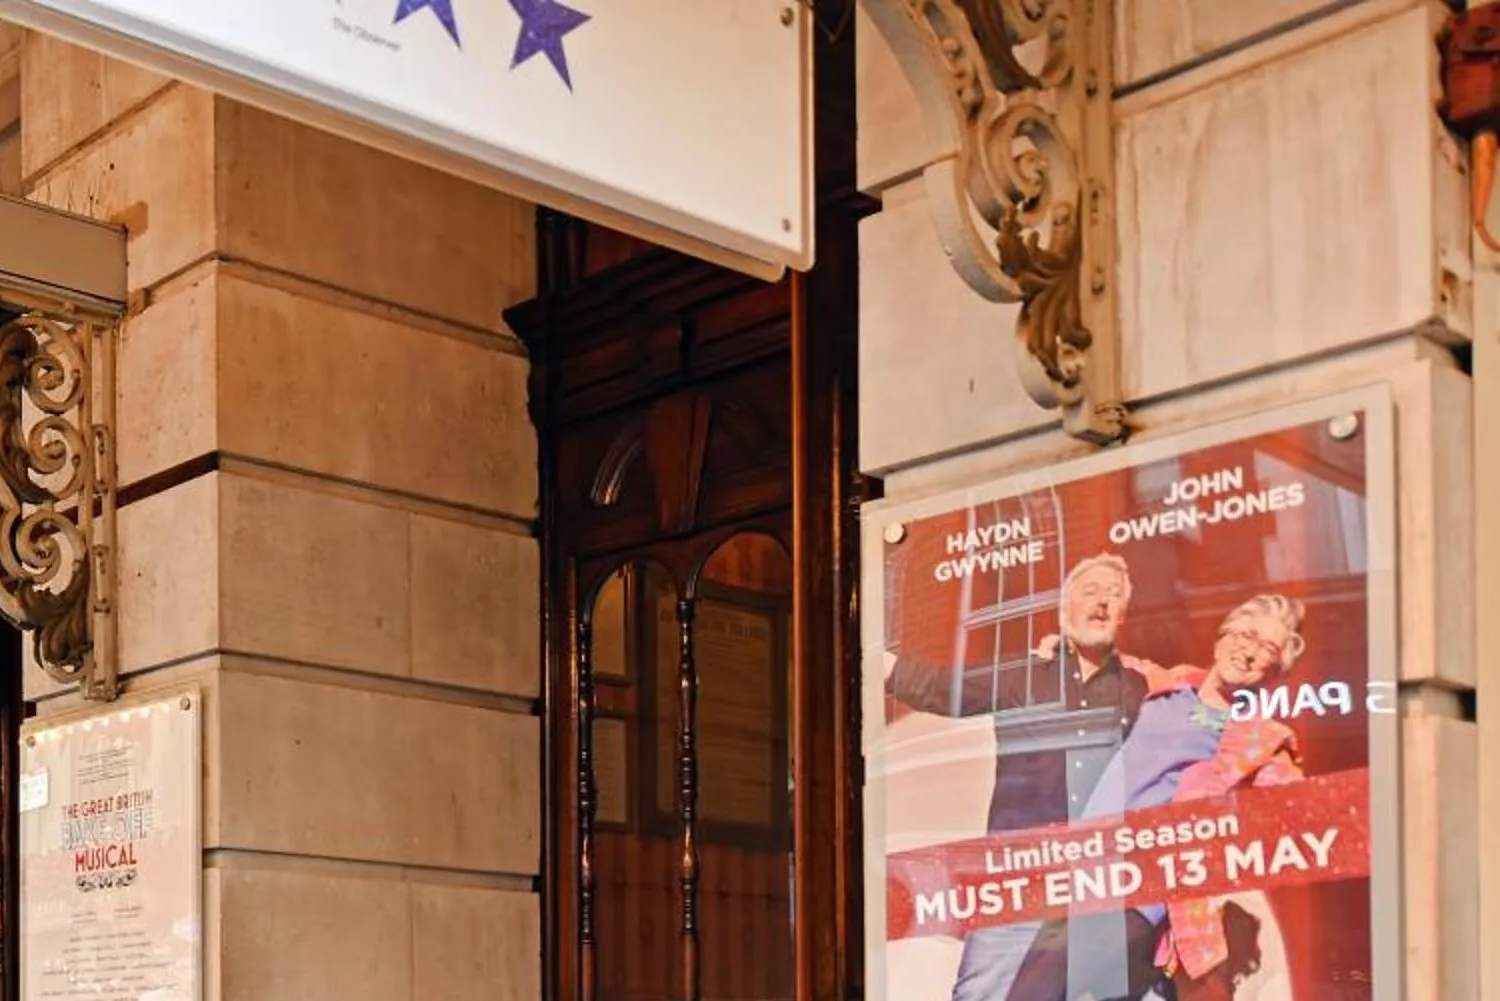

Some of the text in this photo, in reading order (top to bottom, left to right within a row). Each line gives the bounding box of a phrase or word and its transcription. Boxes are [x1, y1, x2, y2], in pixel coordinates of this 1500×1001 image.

[1163, 466, 1243, 506] JOHN
[1108, 482, 1305, 545] OWEN-JONES
[946, 516, 1031, 555] HAYDN
[934, 540, 1045, 583] GWYNNE
[62, 803, 79, 819] THE
[83, 797, 114, 817] GREAT
[75, 843, 137, 872] MUSICAL
[985, 814, 1240, 875] Limited Season
[914, 828, 1340, 926] MUST END 13 MAY
